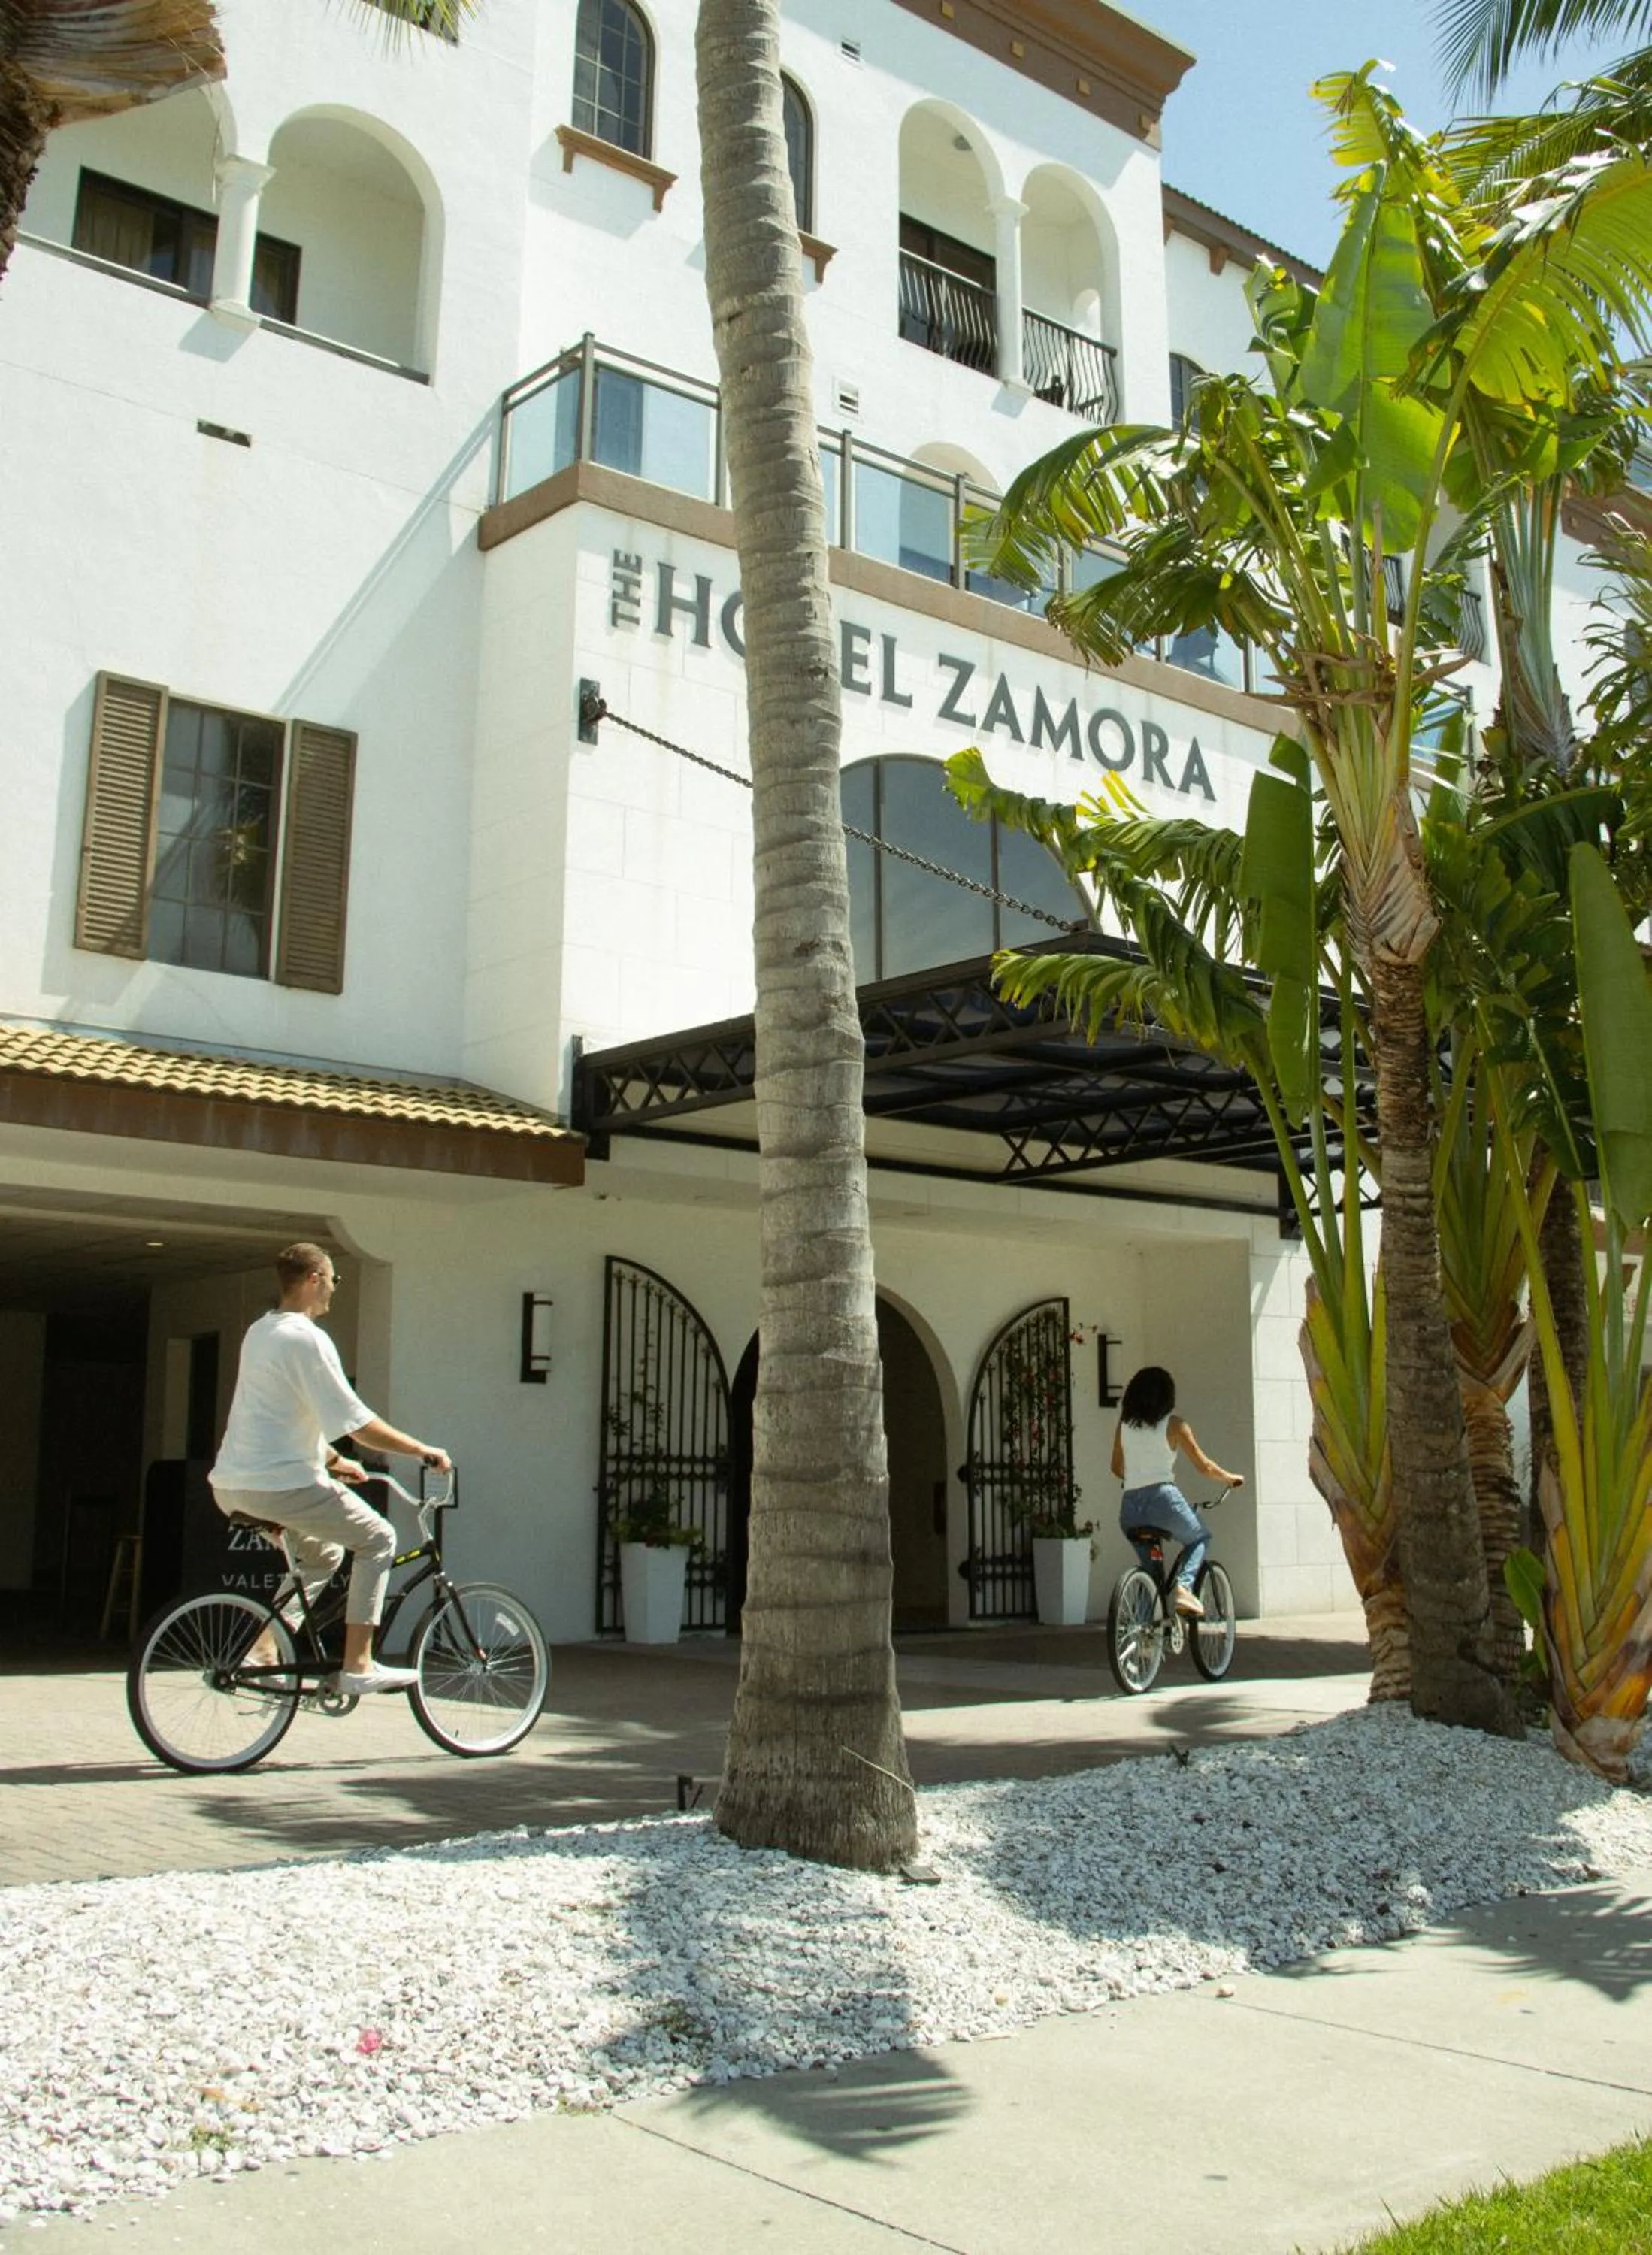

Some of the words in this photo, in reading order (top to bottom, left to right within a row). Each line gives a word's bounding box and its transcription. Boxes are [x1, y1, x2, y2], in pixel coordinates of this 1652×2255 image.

[611, 549, 643, 628] THE
[653, 561, 913, 709] HEL
[938, 652, 1217, 803] ZAMORA
